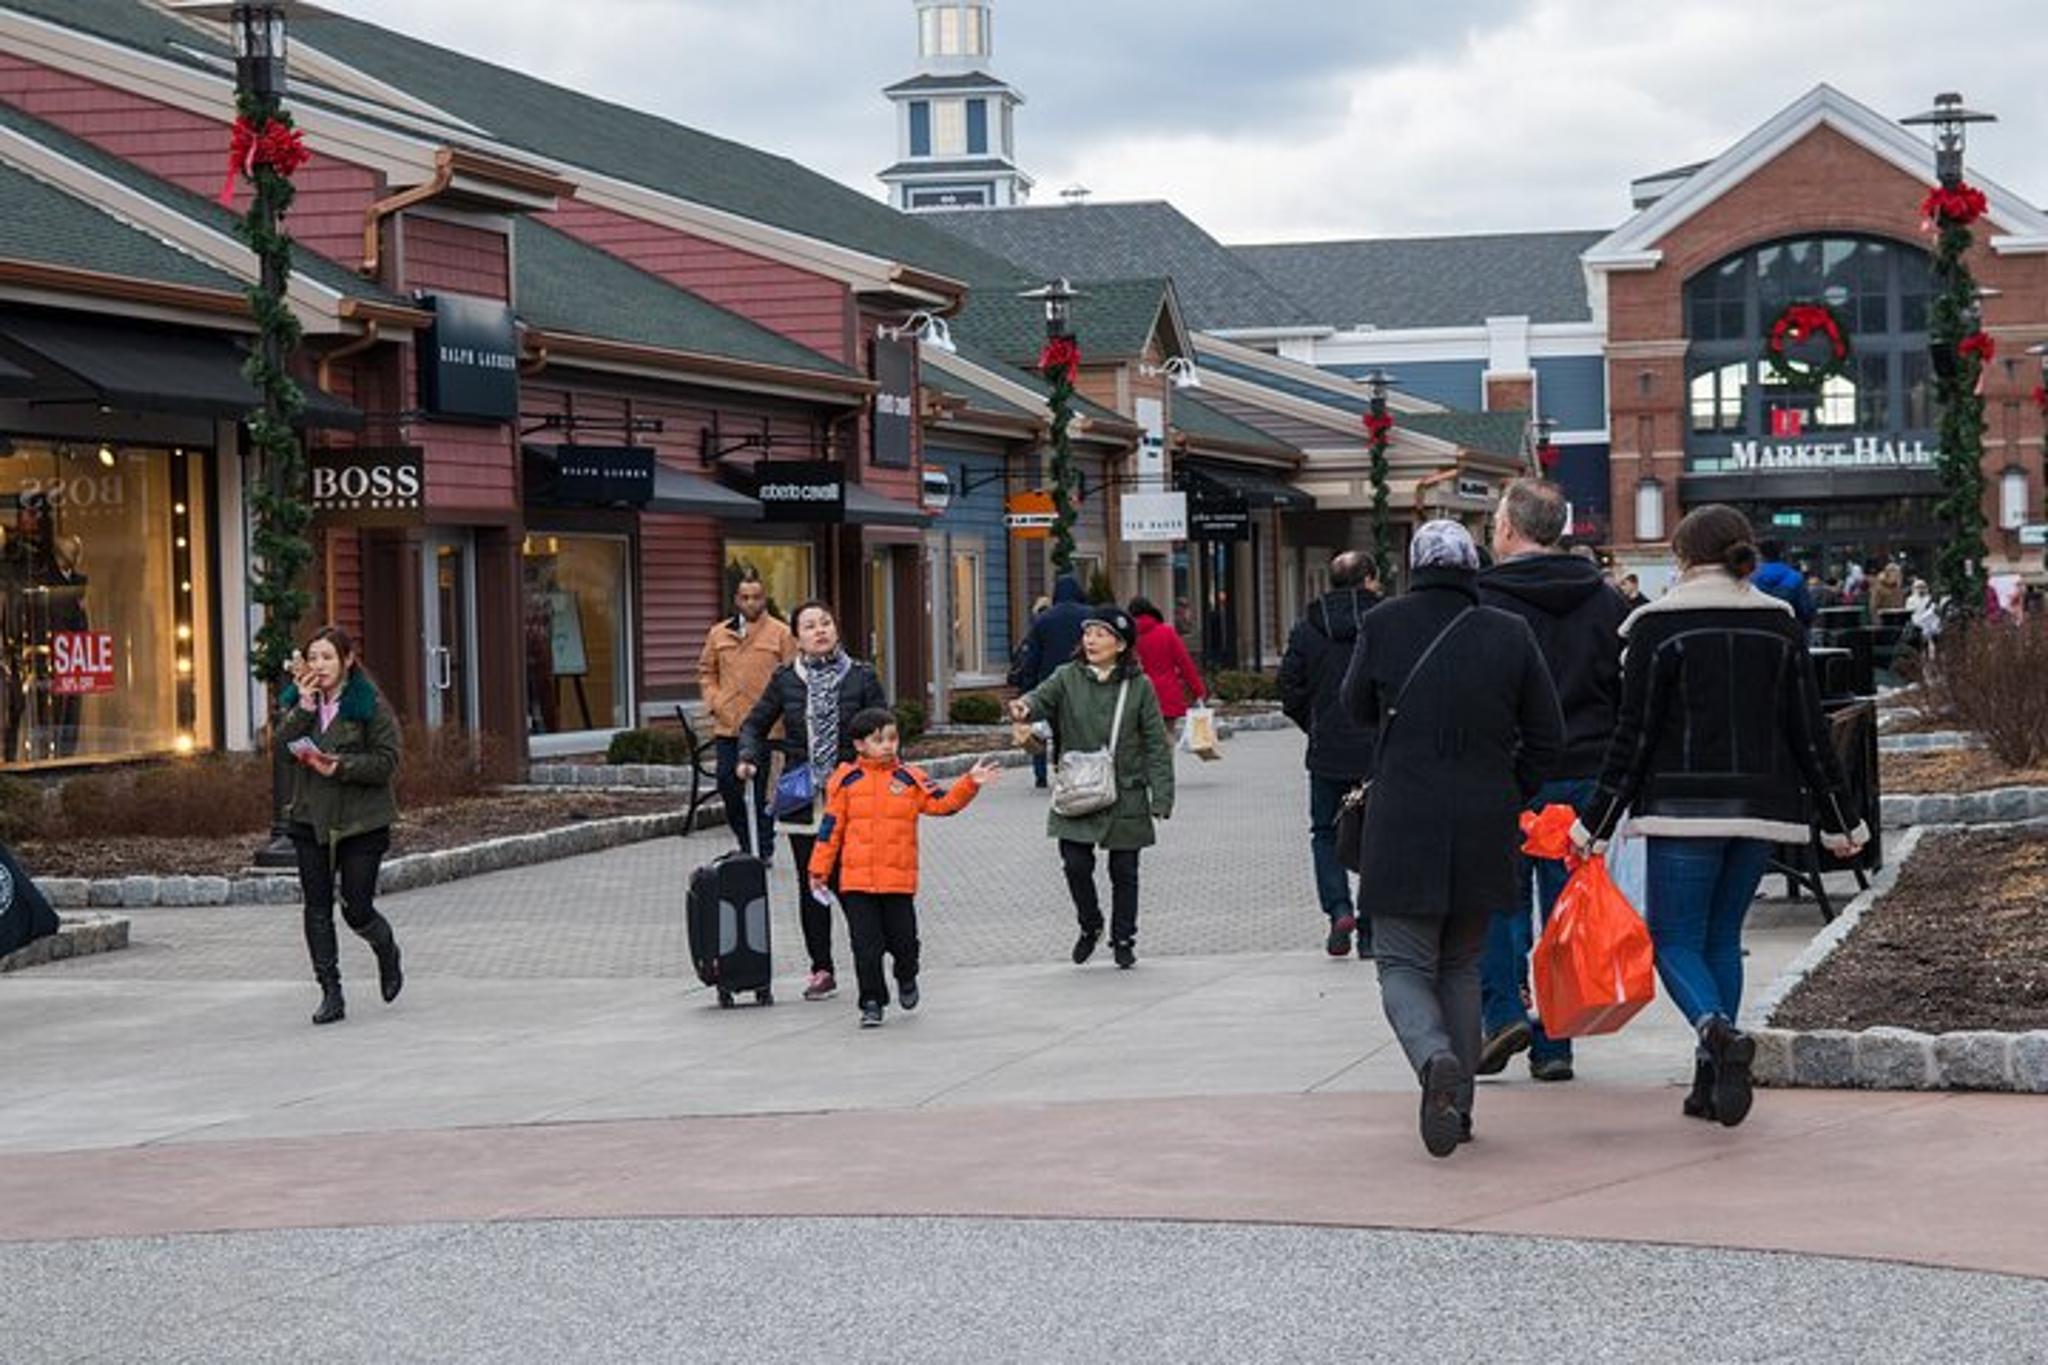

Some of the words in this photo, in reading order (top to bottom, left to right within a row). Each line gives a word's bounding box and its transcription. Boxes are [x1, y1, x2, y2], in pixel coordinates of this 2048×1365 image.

[1853, 437, 1930, 466] HALL
[313, 465, 419, 498] BOSS
[54, 634, 113, 675] SALE
